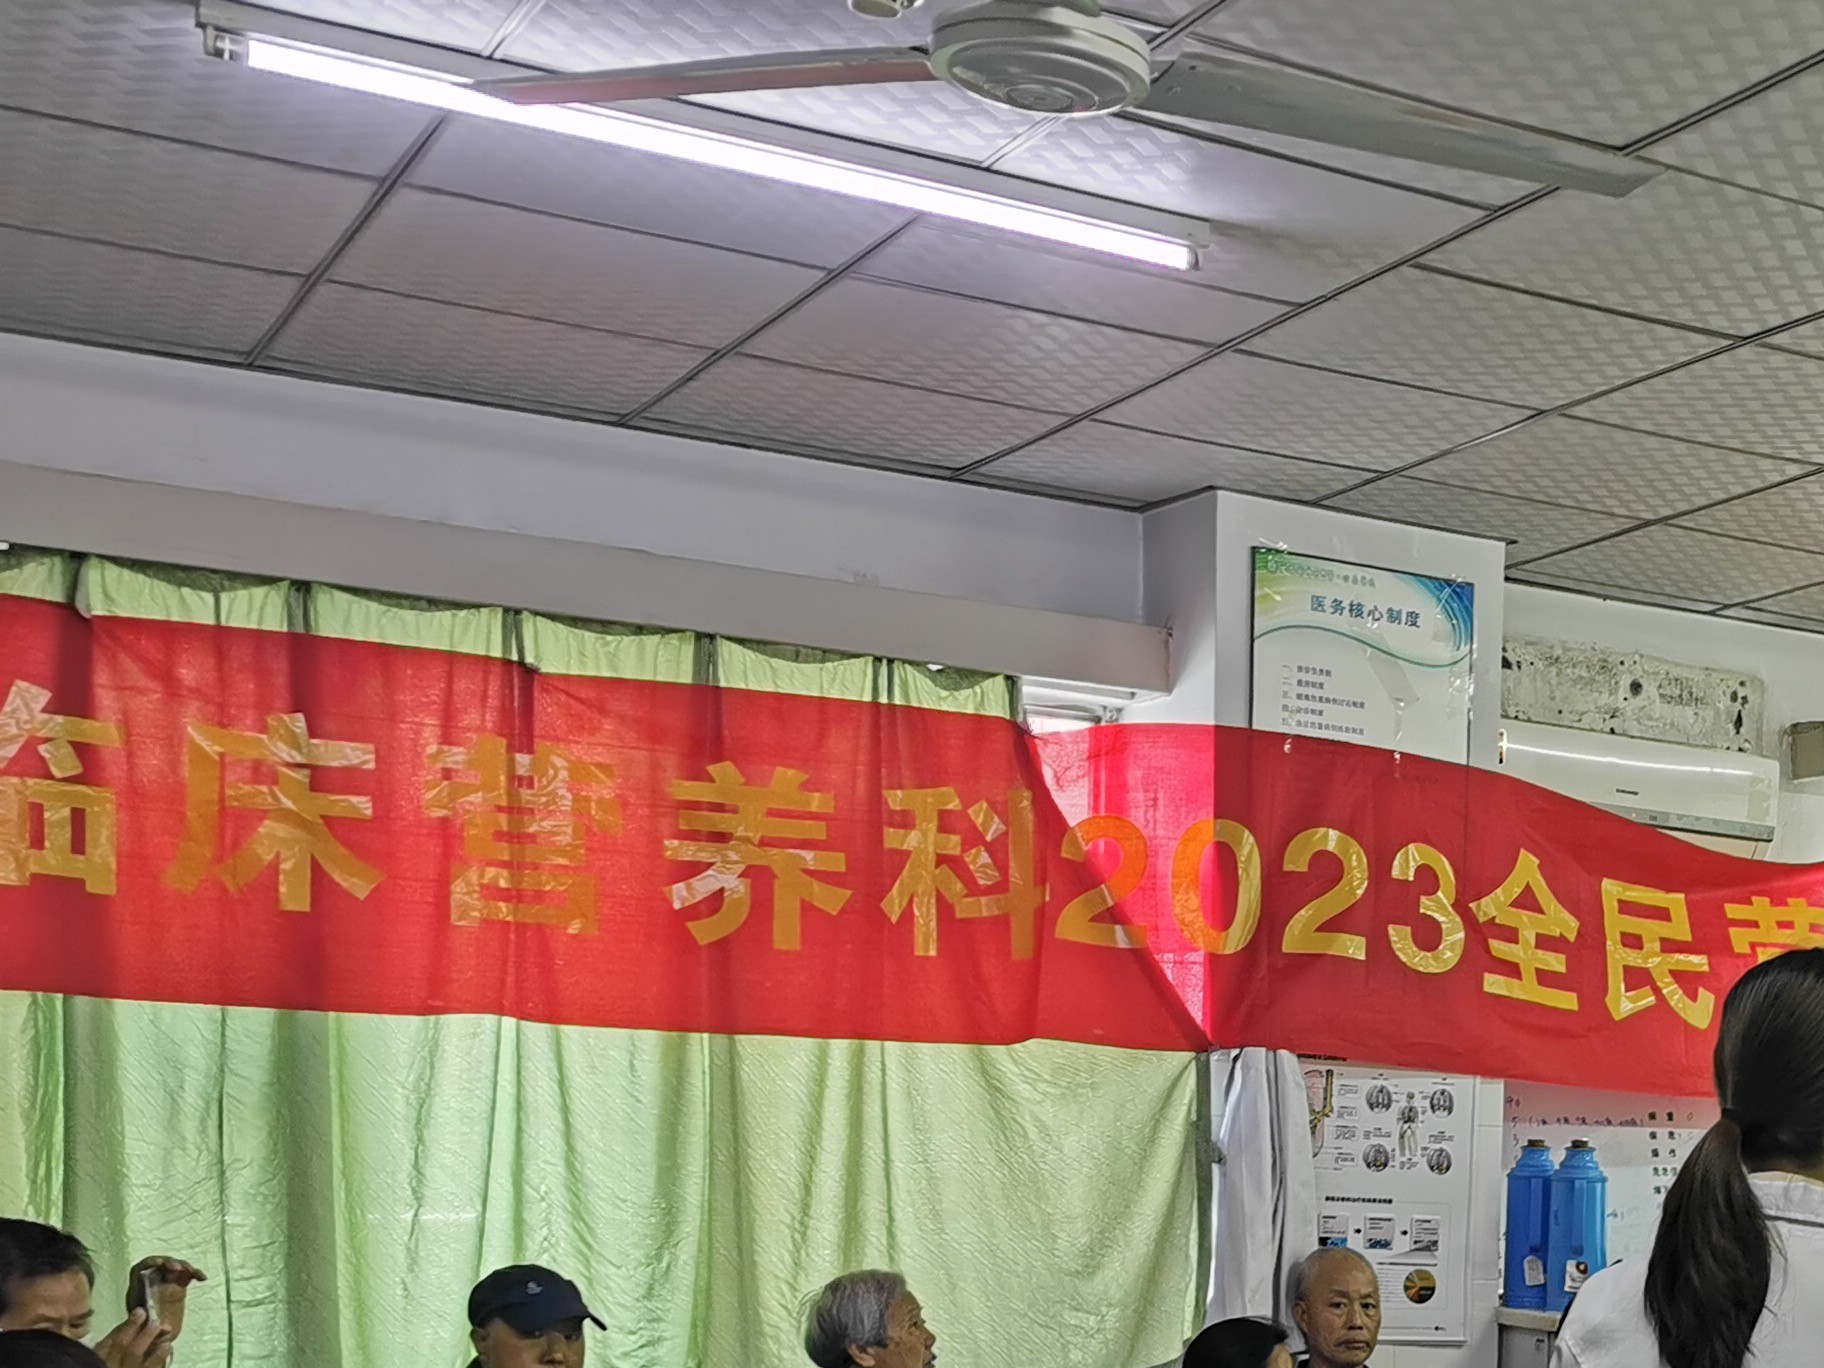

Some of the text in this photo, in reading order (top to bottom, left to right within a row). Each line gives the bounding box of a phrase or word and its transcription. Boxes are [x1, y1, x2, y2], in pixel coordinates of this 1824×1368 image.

[1311, 594, 1421, 628] 医务核心制度
